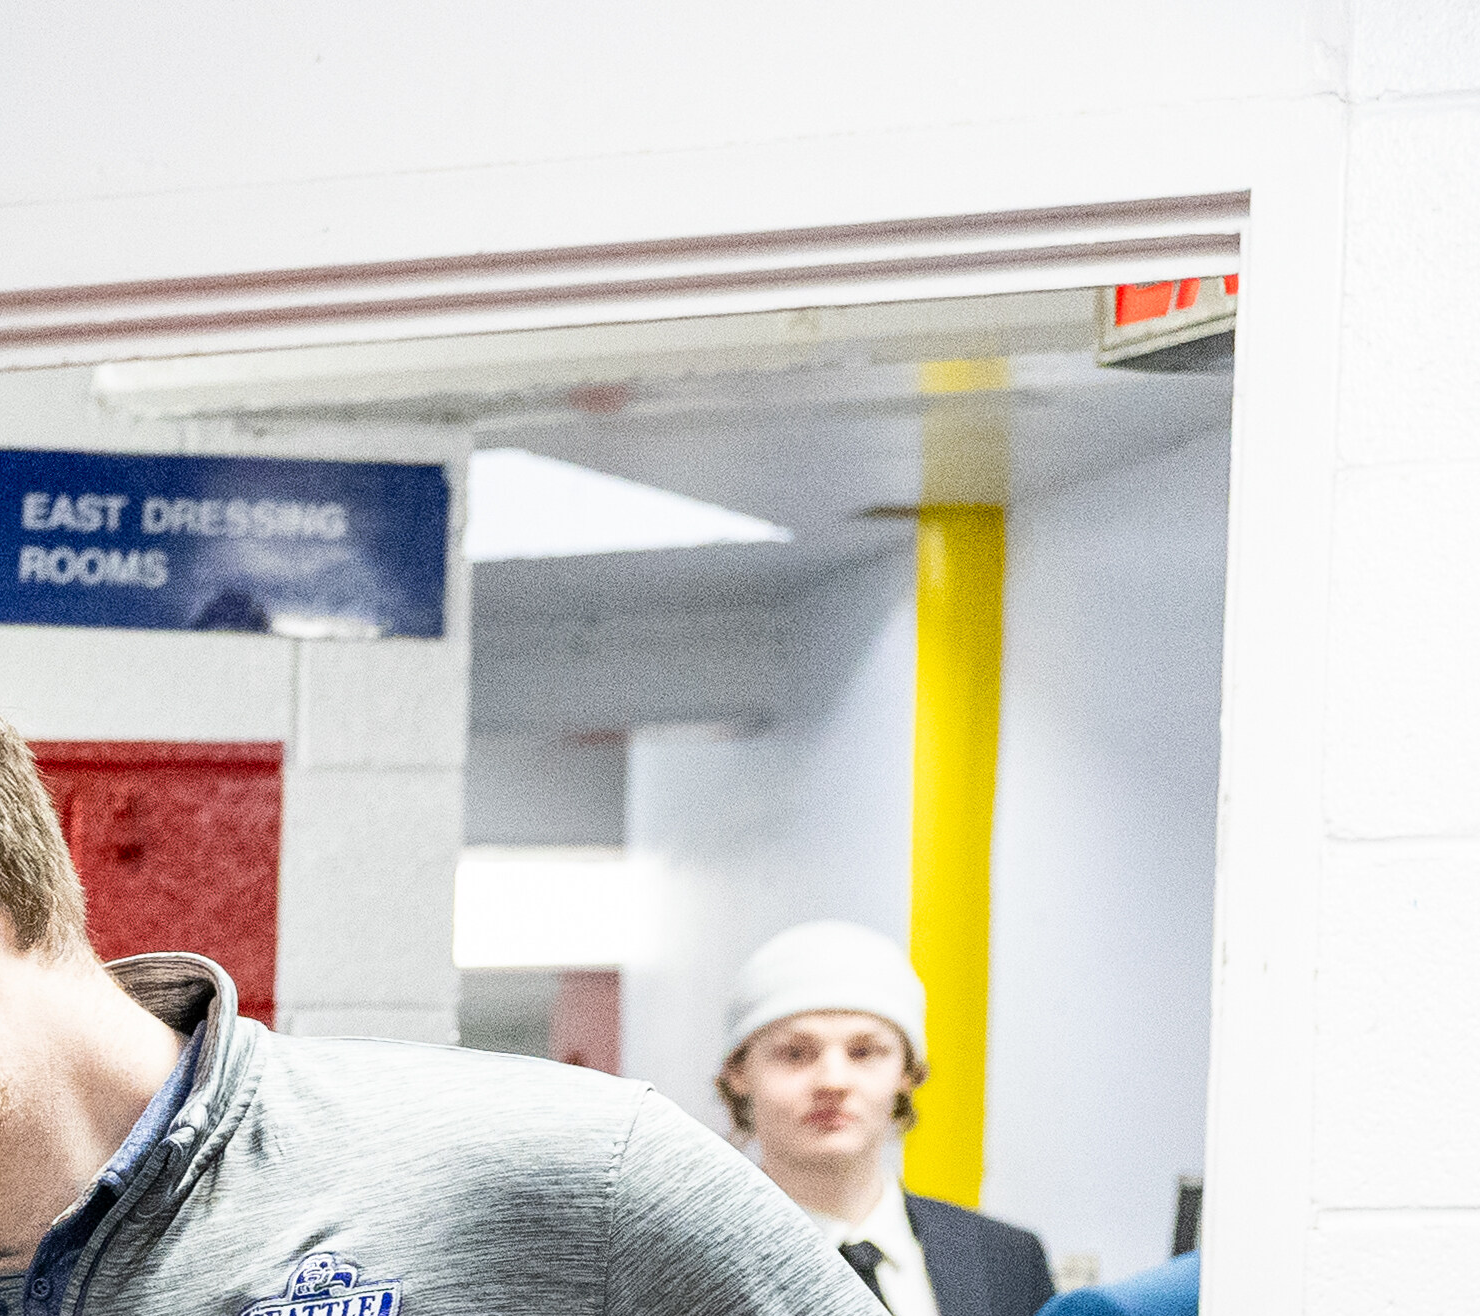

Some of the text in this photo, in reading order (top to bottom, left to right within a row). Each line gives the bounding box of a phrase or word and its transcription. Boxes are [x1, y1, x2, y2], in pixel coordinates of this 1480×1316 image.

[20, 491, 348, 540] EAST DRESSING
[18, 545, 168, 588] ROOMS
